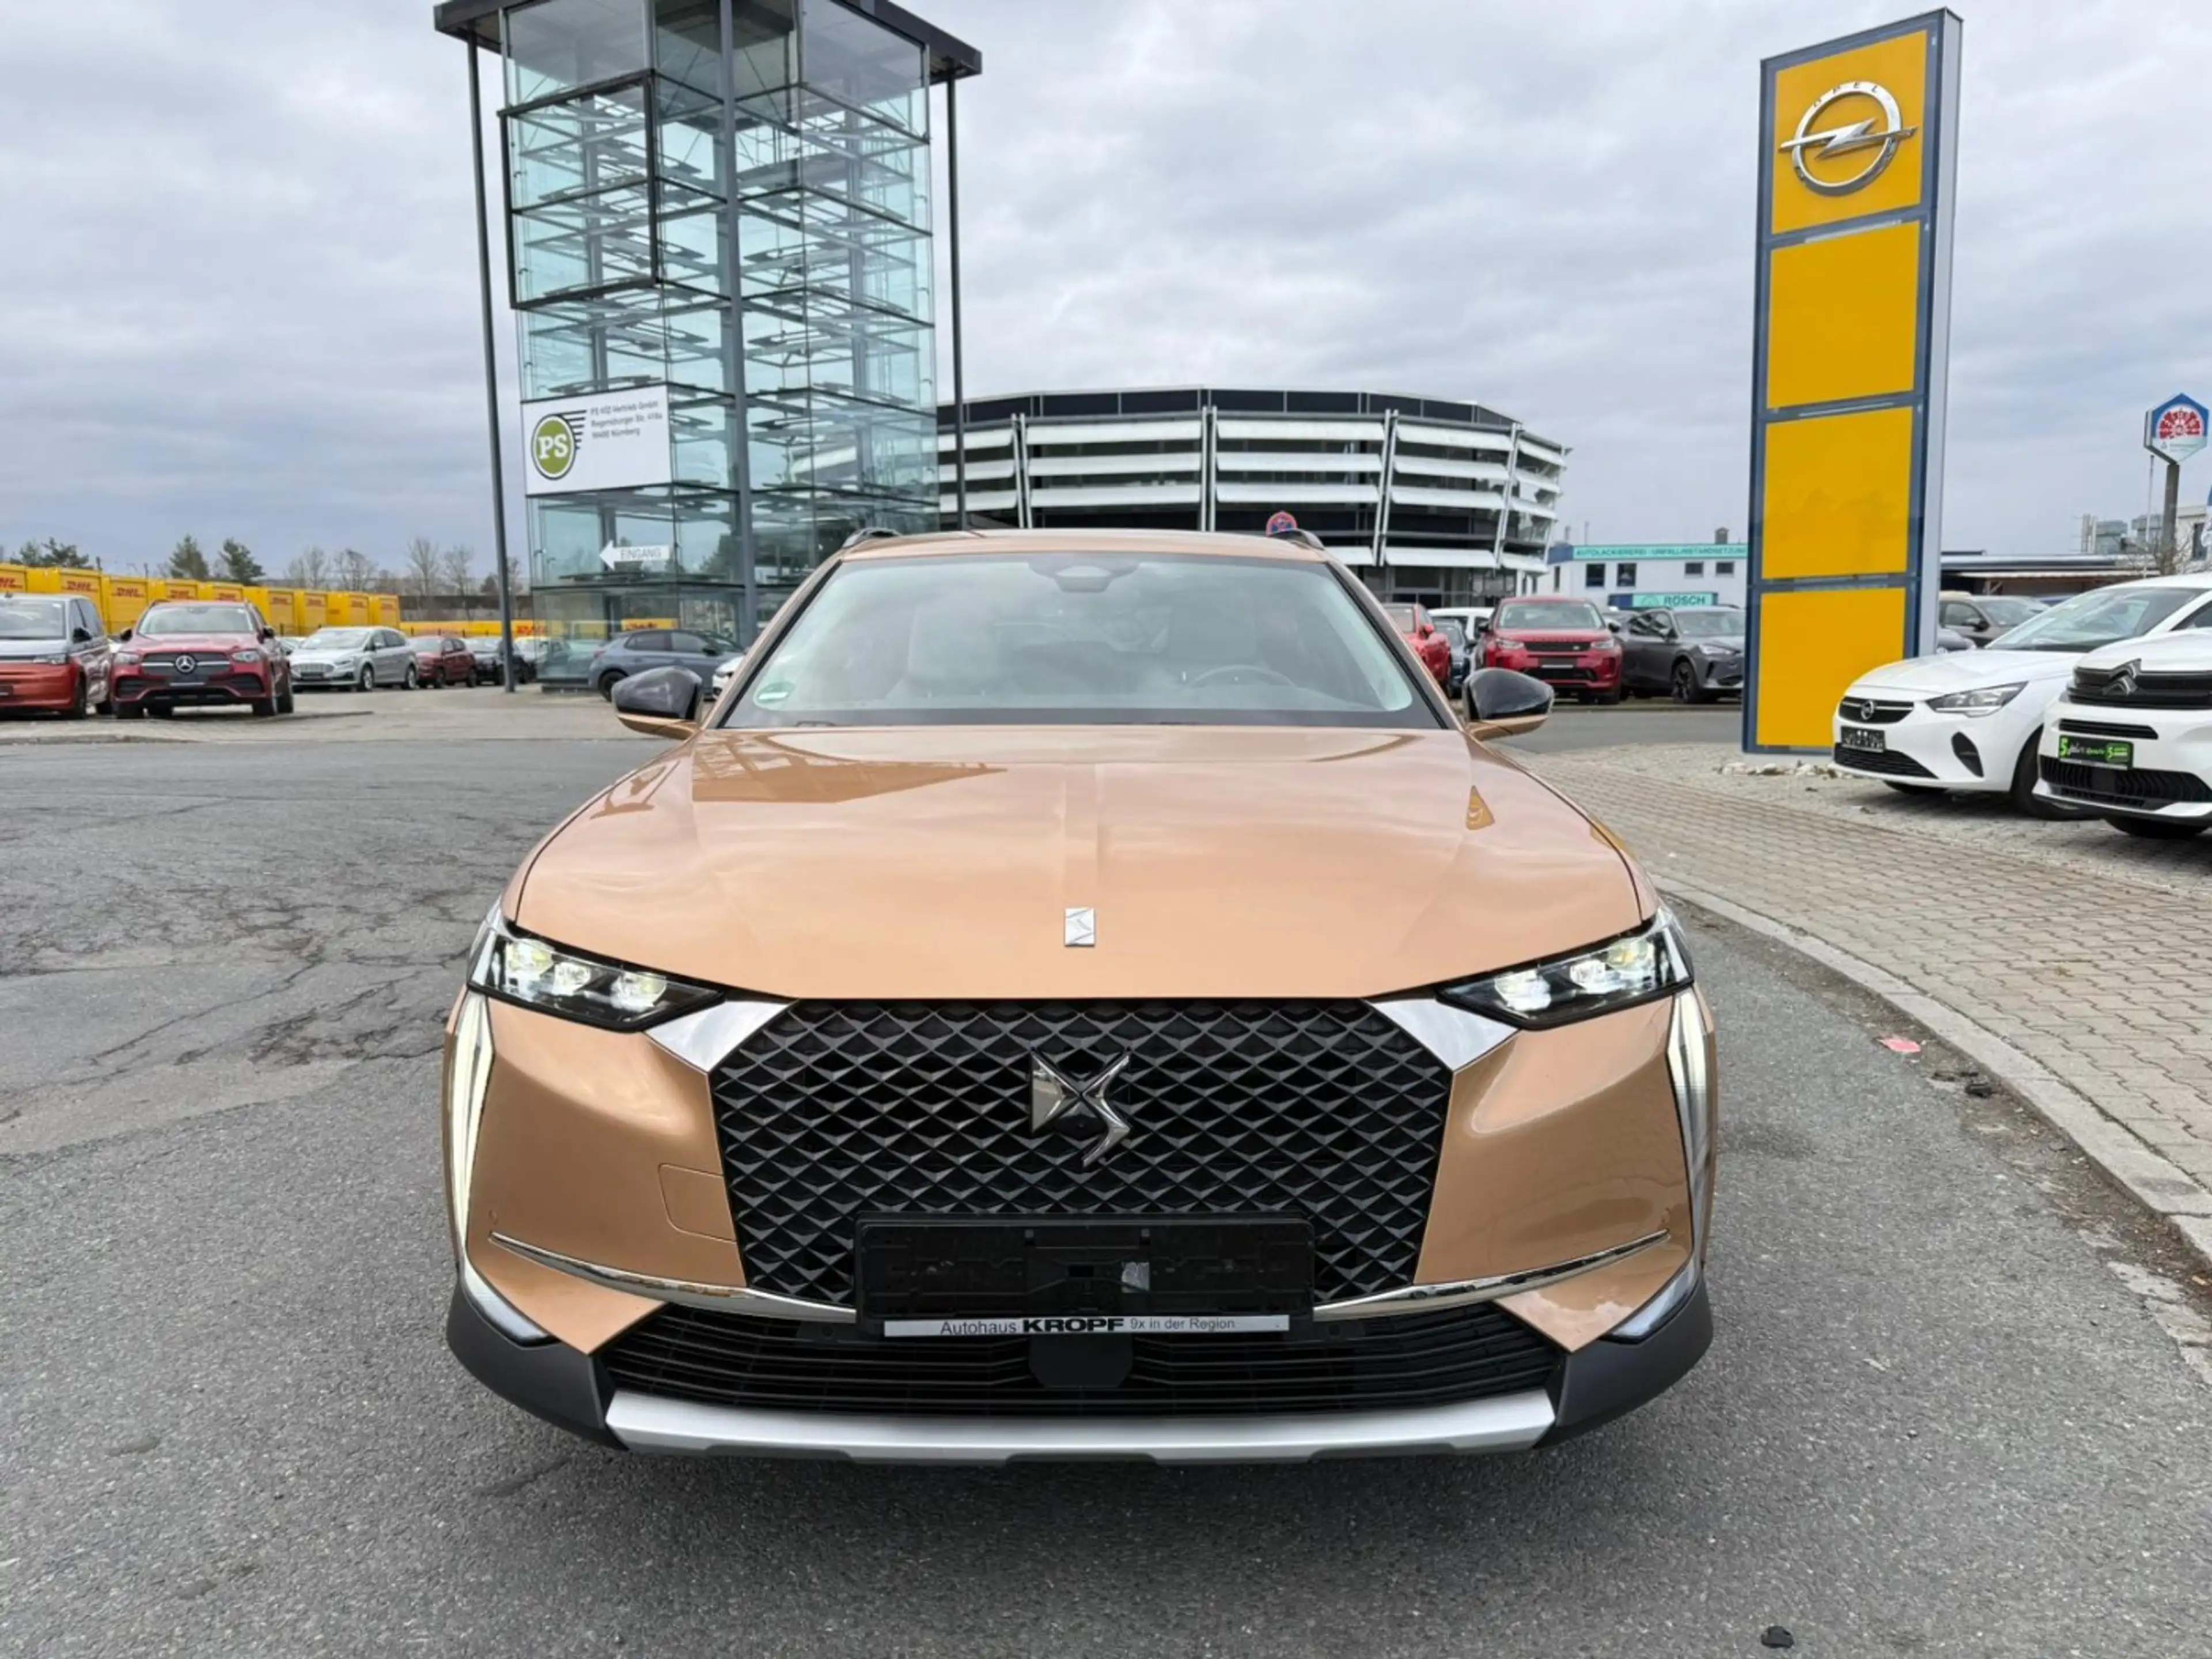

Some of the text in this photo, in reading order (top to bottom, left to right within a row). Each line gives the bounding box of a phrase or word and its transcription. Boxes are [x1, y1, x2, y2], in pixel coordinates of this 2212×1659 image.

[538, 434, 568, 459] PS
[941, 1317, 1236, 1335] Autohaus KROPF 9x in der Region
